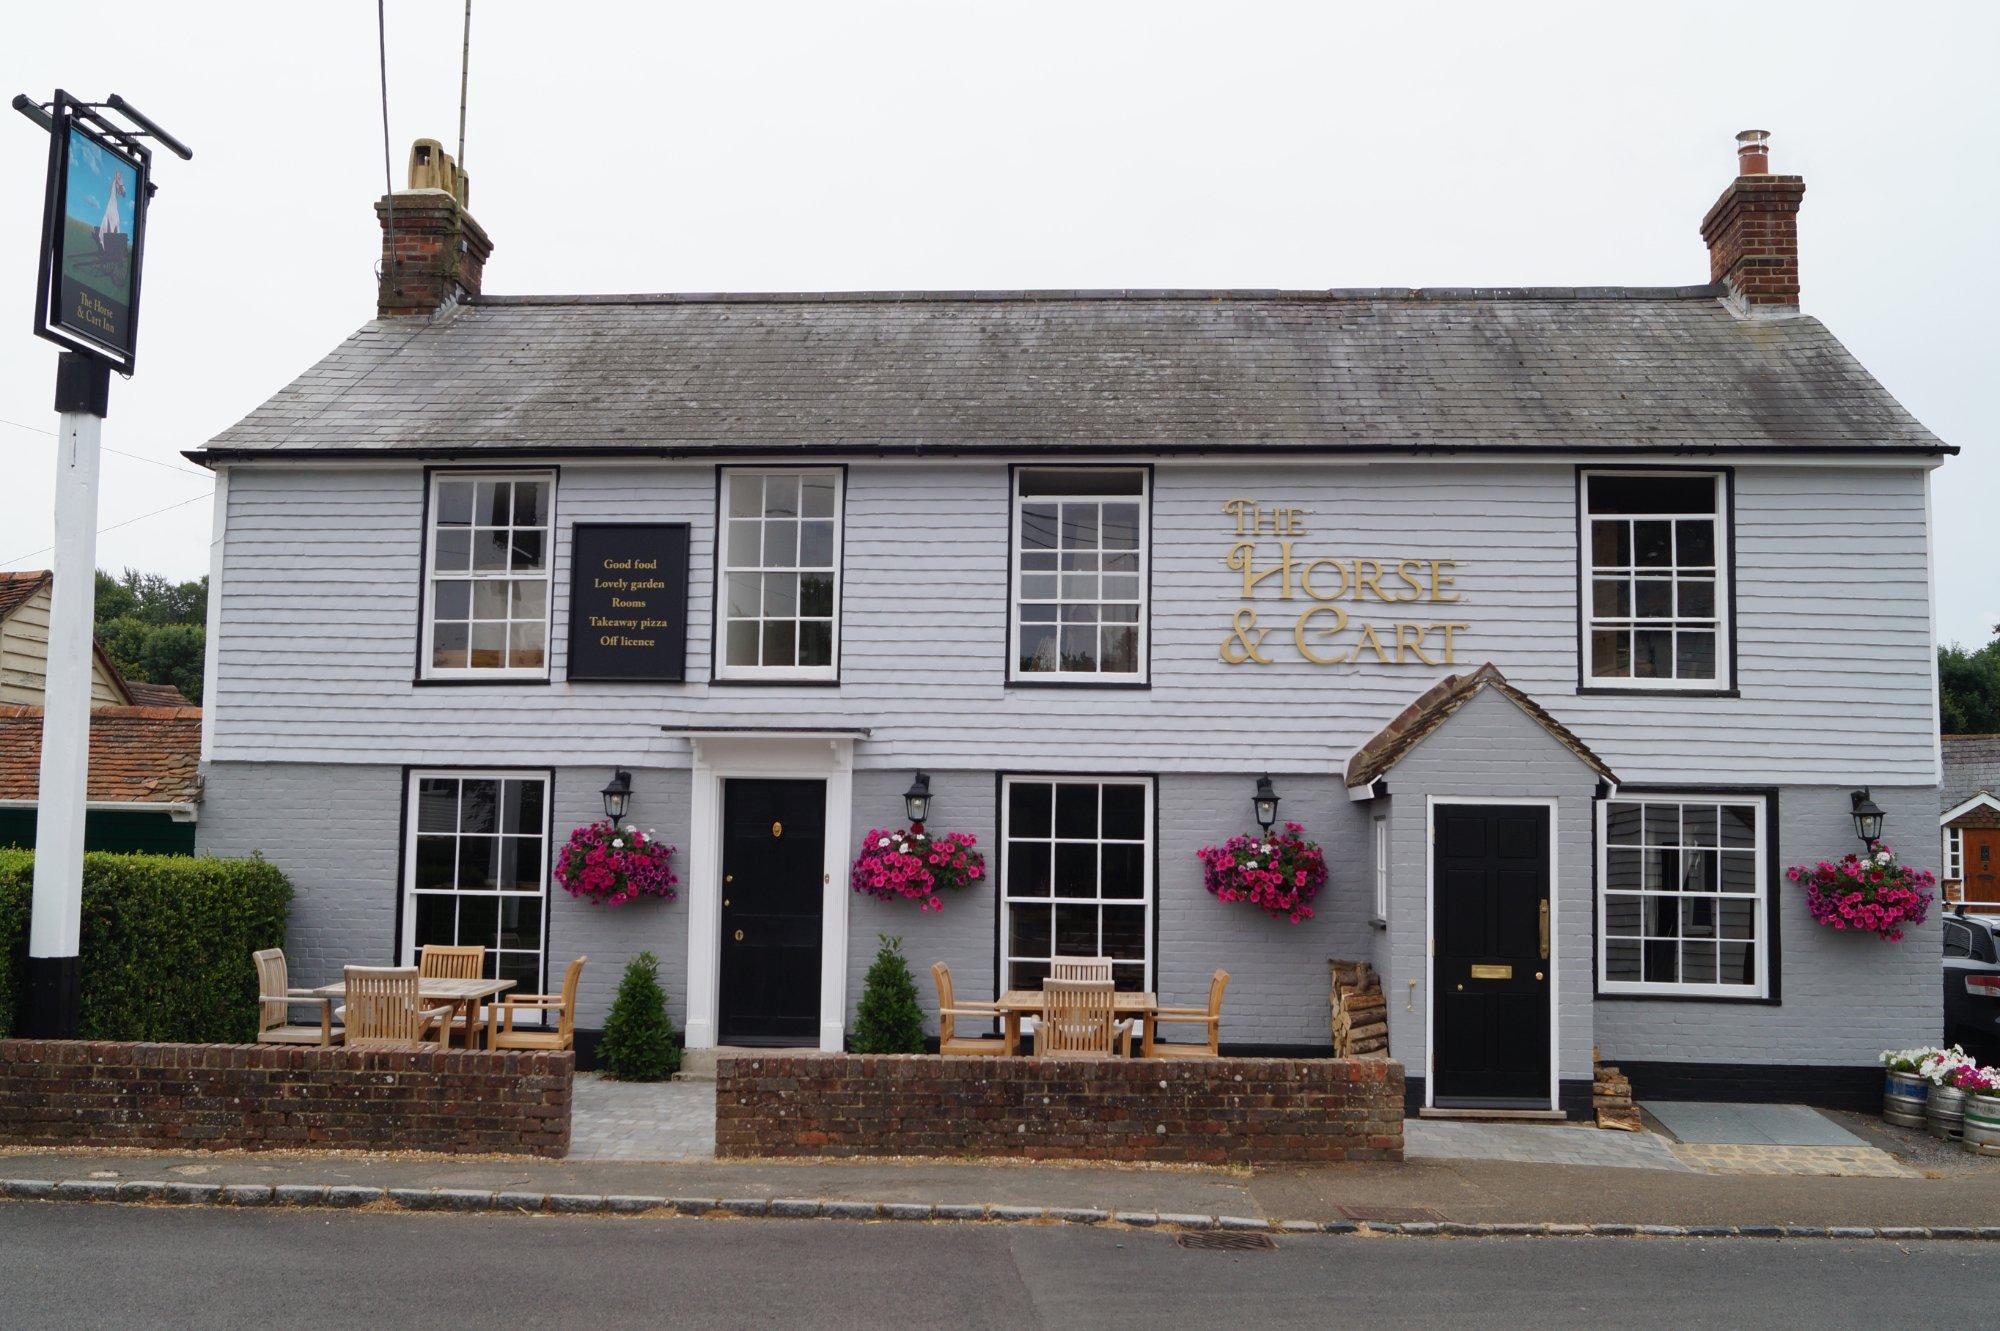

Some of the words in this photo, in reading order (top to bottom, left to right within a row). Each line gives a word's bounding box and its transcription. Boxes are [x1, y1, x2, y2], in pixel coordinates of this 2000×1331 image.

[80, 291, 92, 308] The
[94, 298, 113, 318] Horse
[77, 305, 84, 319] &
[86, 309, 102, 327] Cart
[103, 317, 115, 333] Inn
[1222, 498, 1308, 536] THE
[604, 559, 631, 569] Good
[634, 559, 657, 569] food
[1226, 540, 1461, 603] HORSE
[594, 578, 629, 591] Lovely
[631, 579, 665, 591] garden
[612, 597, 646, 608] Rooms
[589, 616, 638, 630] Takeaway
[640, 618, 668, 630] pizza
[600, 635, 619, 646] Off
[621, 636, 655, 646] licence
[1219, 607, 1273, 665] &
[1295, 605, 1470, 666] CART
